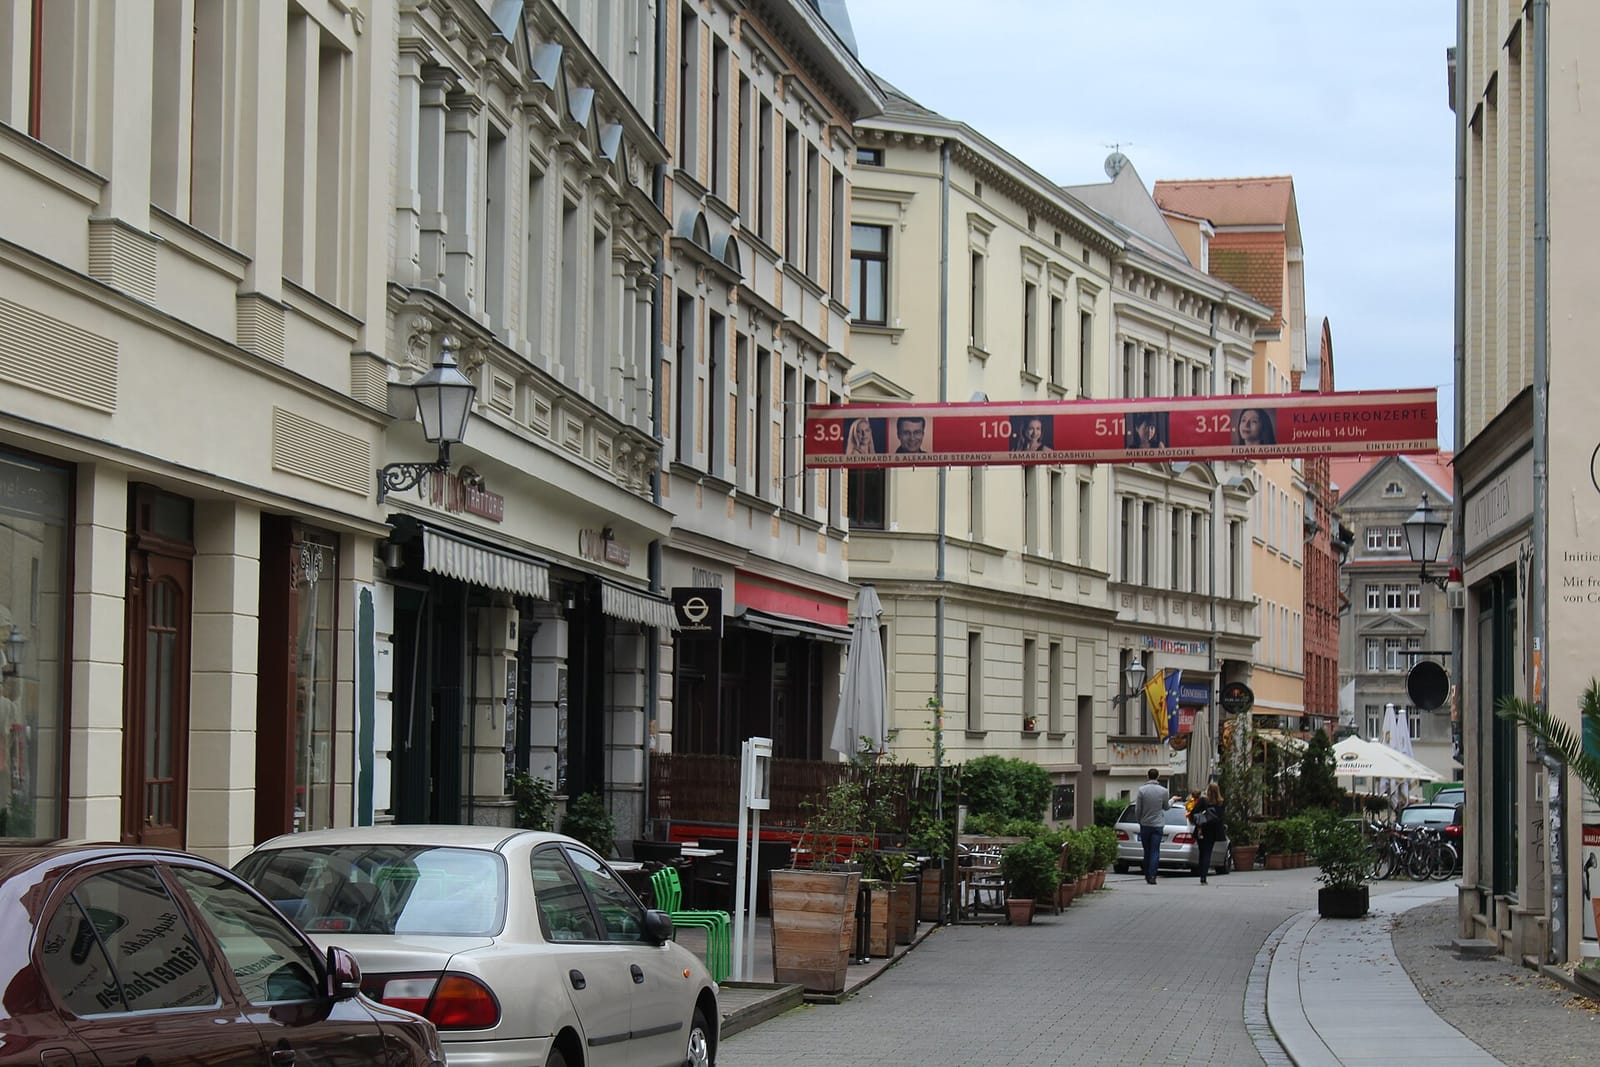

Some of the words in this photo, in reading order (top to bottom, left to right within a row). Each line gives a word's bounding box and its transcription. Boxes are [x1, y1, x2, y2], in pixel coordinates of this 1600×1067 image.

[1293, 409, 1428, 424] KLAVIERKONZERTE
[979, 420, 1017, 439] 1.10.
[1095, 418, 1132, 436] 5.11.
[1195, 415, 1236, 433] 3.12.
[813, 424, 844, 441] 3.9.
[1292, 427, 1331, 441] jeweils
[1334, 426, 1345, 438] 14
[1347, 425, 1368, 437] Uhr
[1231, 446, 1256, 455] FIDAN
[1366, 442, 1406, 451] EINTRITT
[1408, 441, 1428, 449] FREI
[1008, 452, 1039, 460] TAMARI
[1126, 449, 1155, 457] MIKIKO
[1157, 448, 1195, 457] MOTOIKE
[814, 456, 844, 464] NICOLE
[846, 454, 892, 463] MEINHARDT
[902, 453, 951, 462] ALEXANDER
[952, 453, 992, 461] STEPANOV
[1564, 551, 1600, 562] Initiie
[1563, 576, 1583, 587] Mit
[1563, 595, 1584, 603] von
